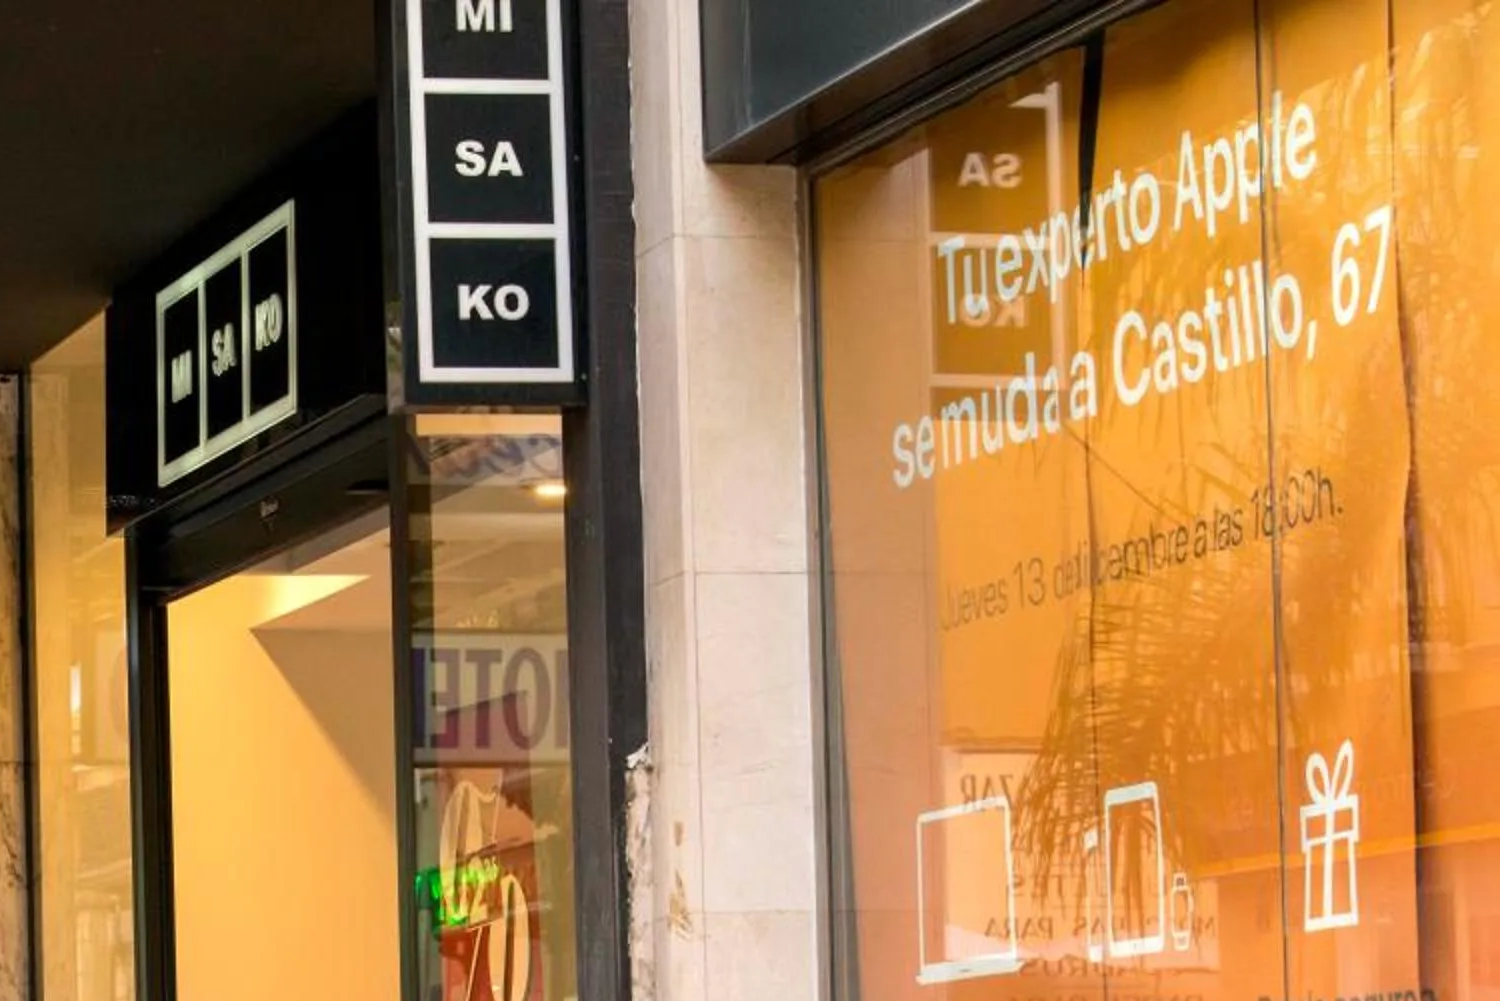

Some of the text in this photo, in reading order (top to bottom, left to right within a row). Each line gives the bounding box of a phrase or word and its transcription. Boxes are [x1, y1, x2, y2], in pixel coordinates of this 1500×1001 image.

[456, 0, 513, 32] MI
[454, 141, 523, 178] SA
[938, 90, 1317, 324] Tu experto Apple
[171, 292, 283, 404] MI SA KO
[457, 284, 530, 321] KO
[893, 204, 1392, 489] se muda a Castillo, 67
[1013, 557, 1047, 610] 13
[1193, 518, 1209, 560] a
[1212, 503, 1244, 552] las
